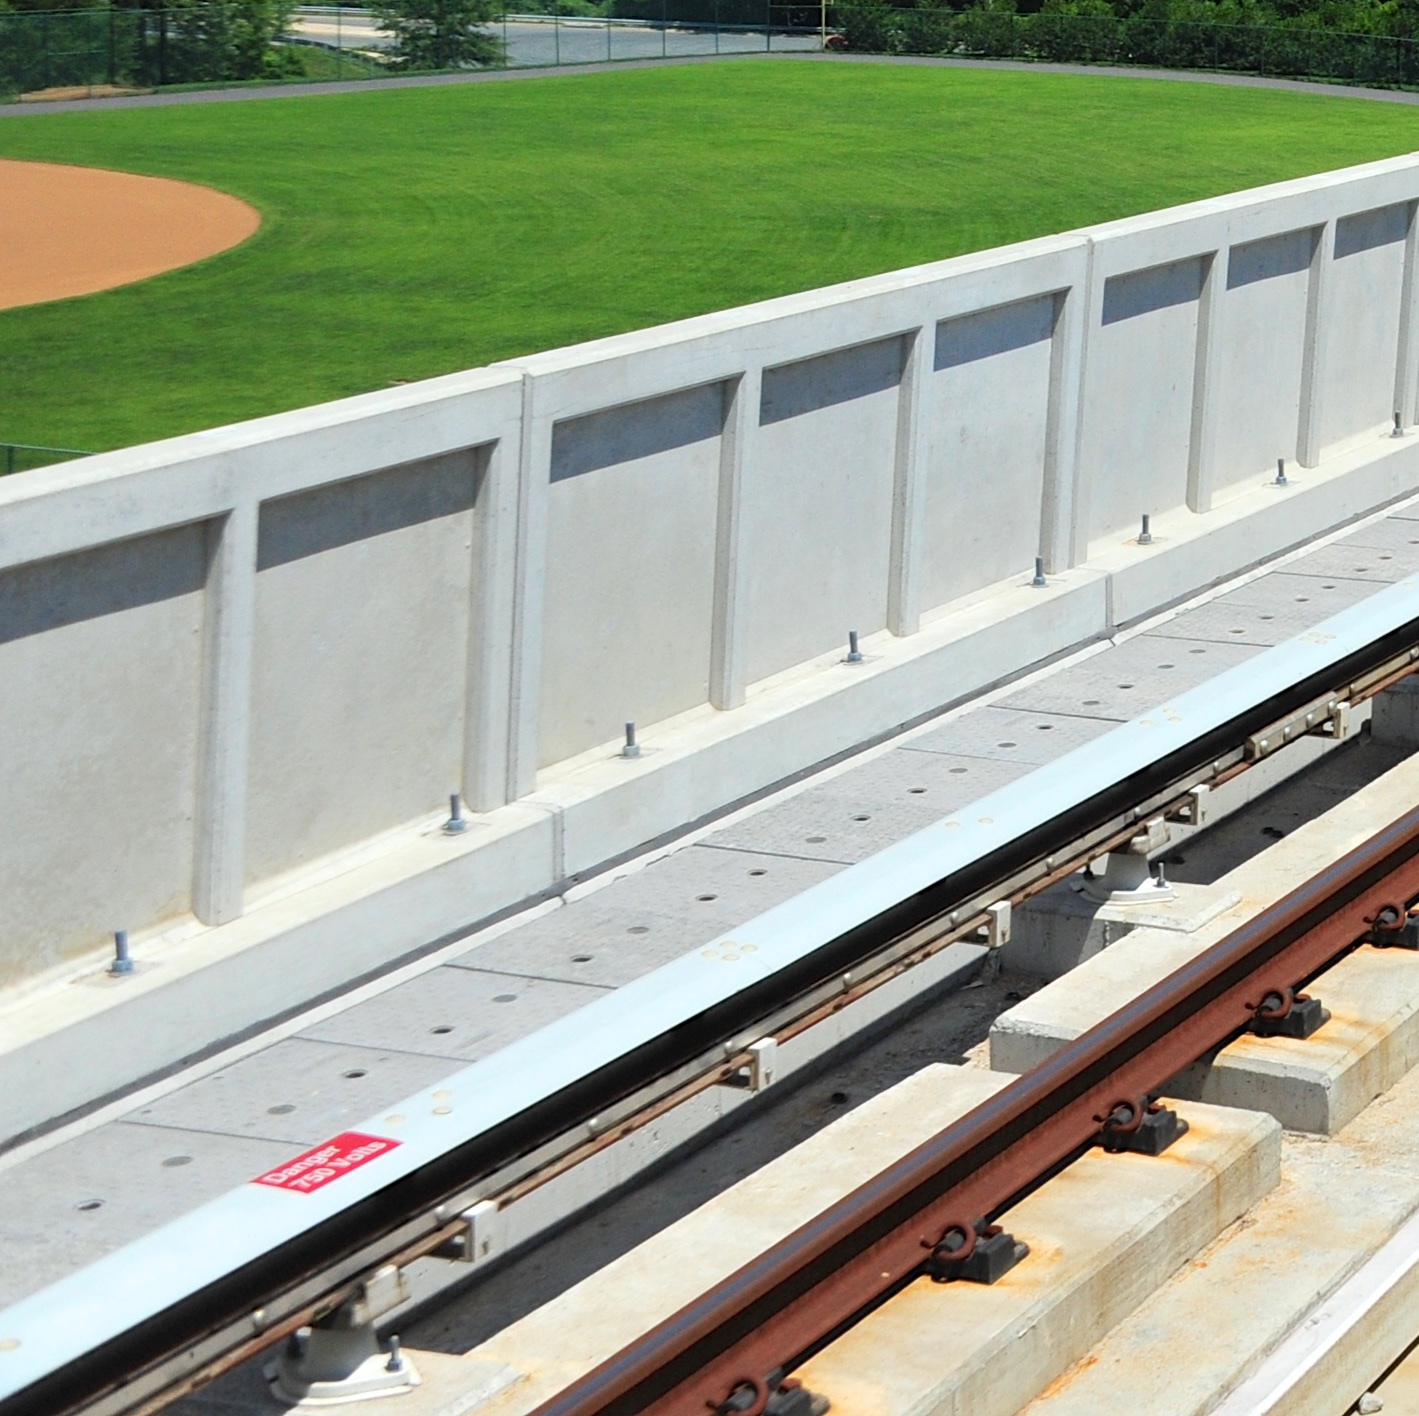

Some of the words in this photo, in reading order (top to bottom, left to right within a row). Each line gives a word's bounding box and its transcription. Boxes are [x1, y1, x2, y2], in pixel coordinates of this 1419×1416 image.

[262, 1145, 341, 1184] Danger
[287, 1167, 337, 1189] 750
[325, 1141, 388, 1168] Volts
